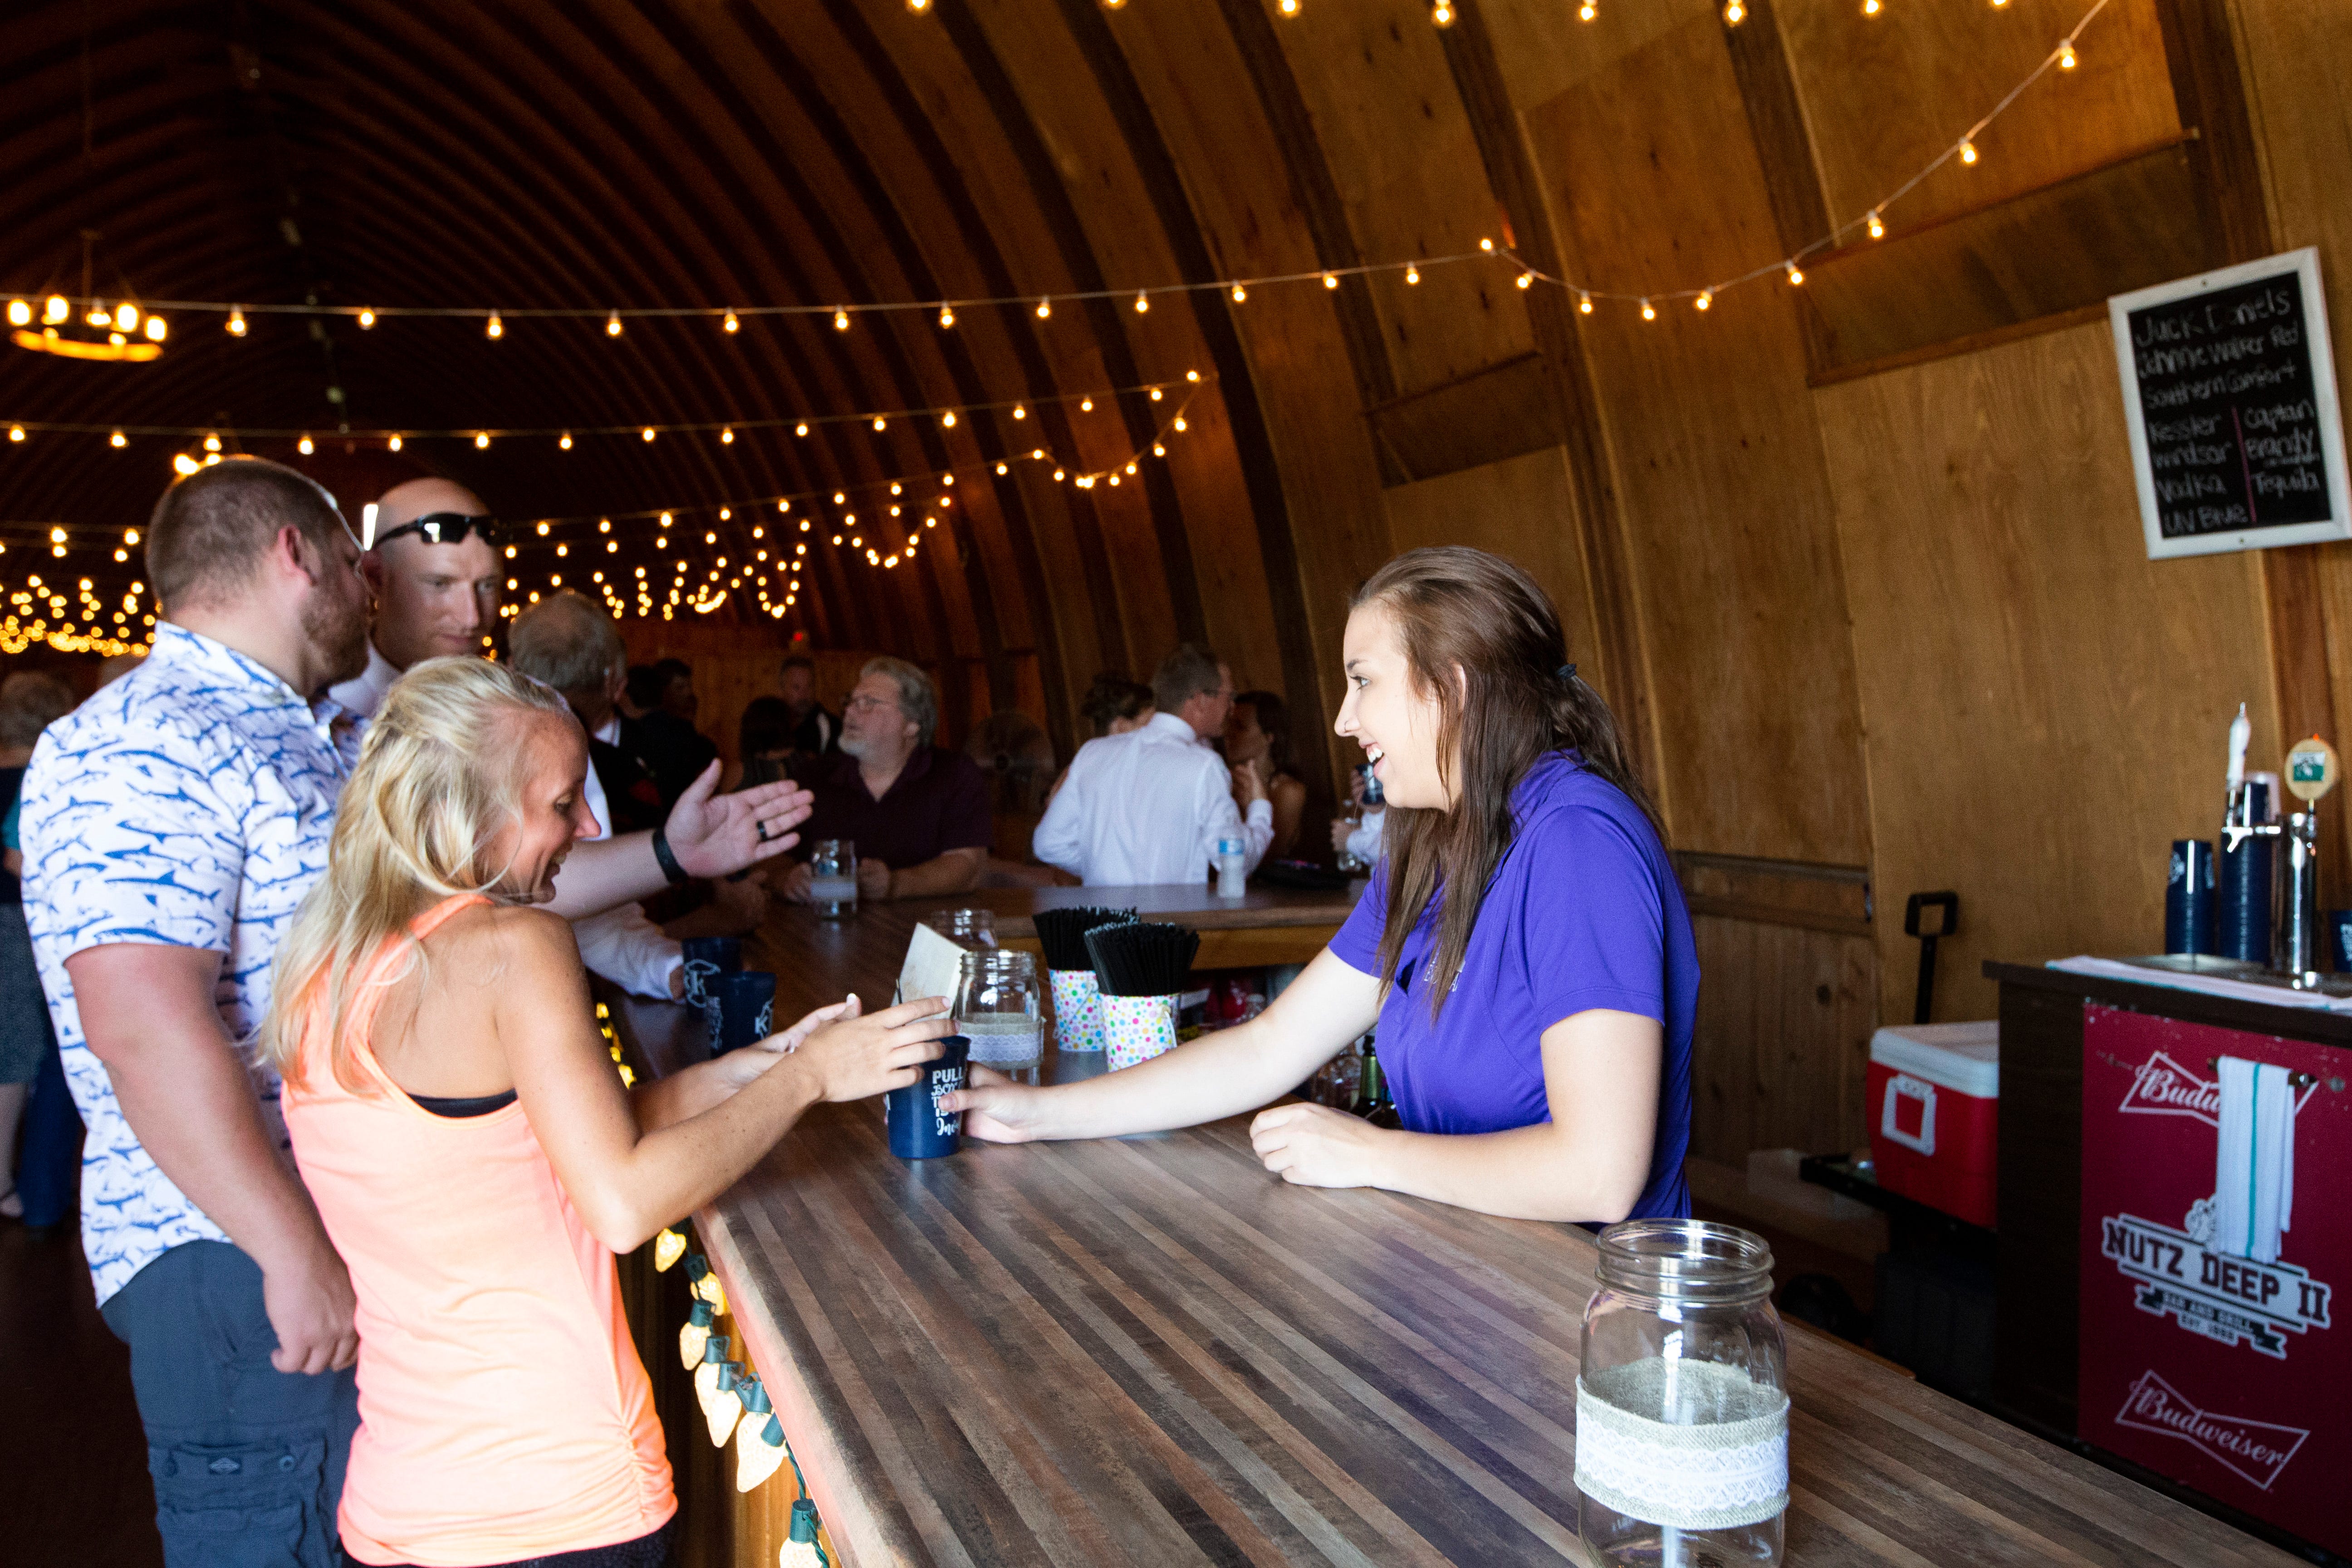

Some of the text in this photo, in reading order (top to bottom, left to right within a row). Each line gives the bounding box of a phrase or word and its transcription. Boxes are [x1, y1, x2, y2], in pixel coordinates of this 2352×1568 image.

[2270, 319, 2298, 348] Red
[2142, 358, 2297, 409] Southern Comfort
[2244, 399, 2314, 432] Captain
[2245, 426, 2313, 460] Brandy
[2252, 466, 2320, 499] Tequila
[932, 1066, 964, 1084] PULL
[2135, 1064, 2221, 1113] Budw
[2106, 1224, 2326, 1322] NUTZ DEEP II
[2129, 1381, 2283, 1466] Budweiser
